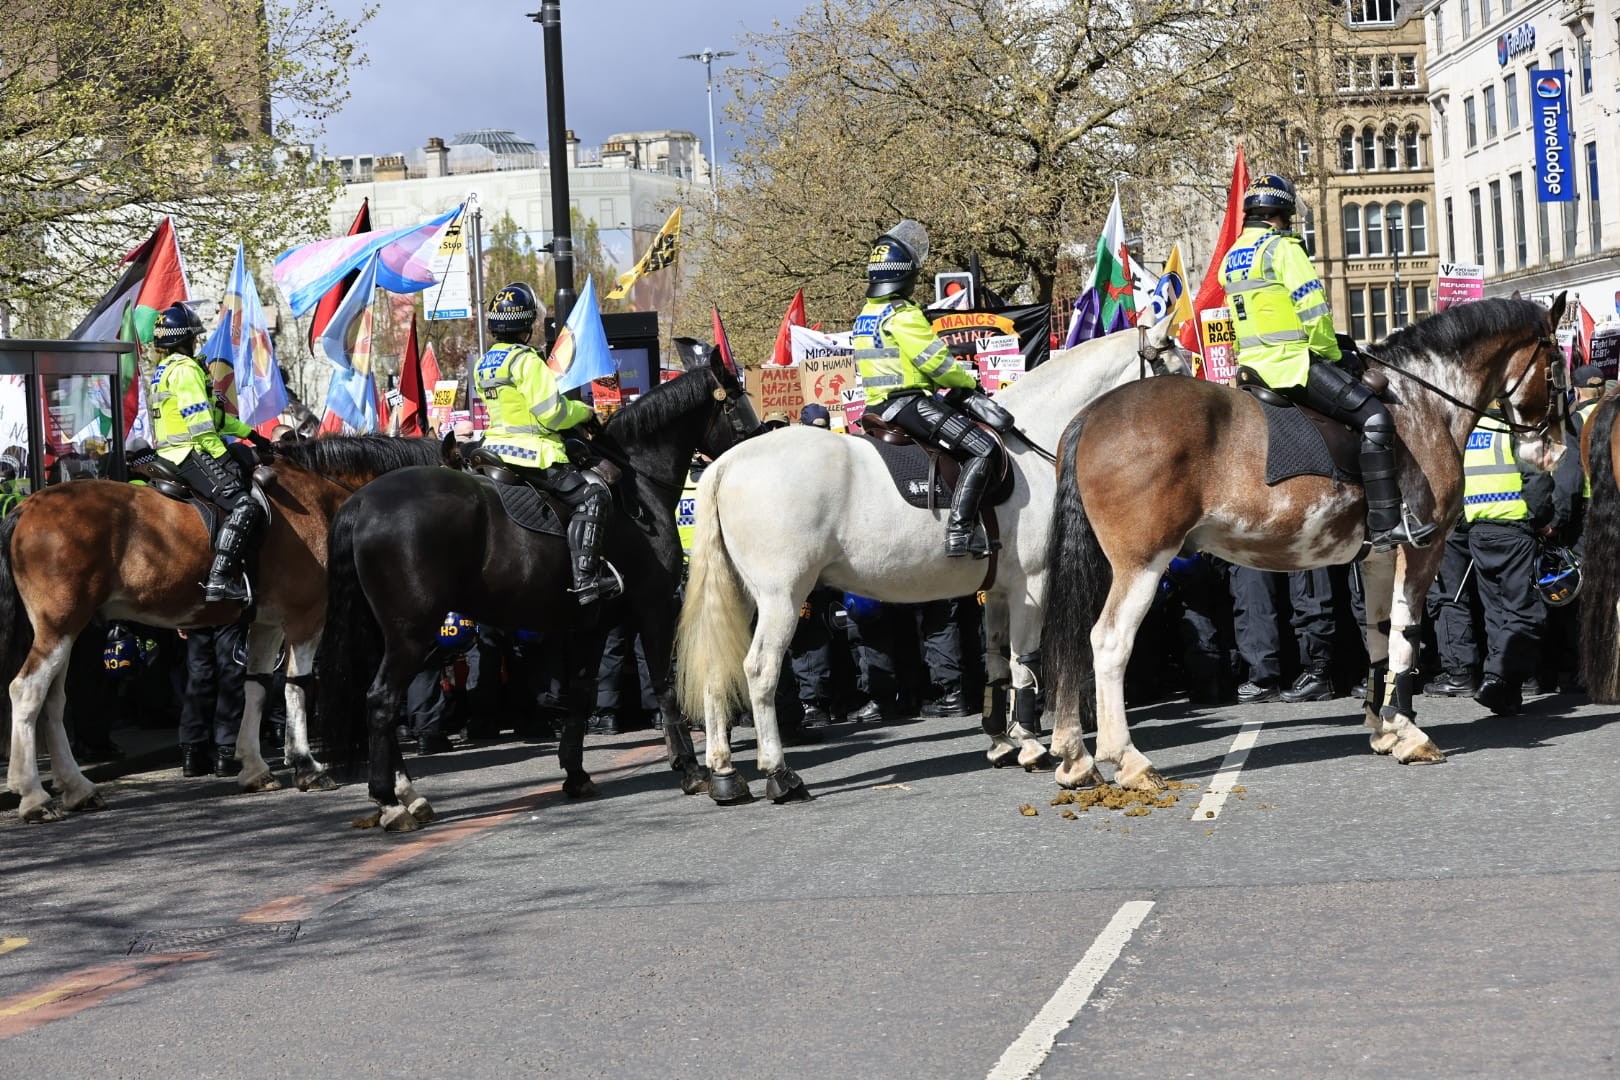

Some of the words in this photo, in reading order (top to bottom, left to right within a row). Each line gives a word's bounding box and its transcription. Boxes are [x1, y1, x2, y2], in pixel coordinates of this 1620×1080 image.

[1543, 101, 1565, 195] Travelodge
[470, 192, 478, 203] R
[443, 241, 462, 250] Stop
[495, 291, 515, 302] CK
[940, 314, 997, 329] MANCS
[1208, 322, 1224, 333] NO
[1209, 331, 1237, 344] RACIS
[1591, 339, 1608, 349] Fight
[1210, 346, 1226, 358] NO
[805, 361, 819, 373] NO
[822, 359, 852, 372] HUMAN
[1211, 357, 1226, 368] TO
[760, 368, 798, 382] MAKE
[435, 390, 443, 398] NO
[443, 390, 451, 398] TO
[761, 381, 802, 396] NAZIS
[762, 395, 805, 408] SCARED
